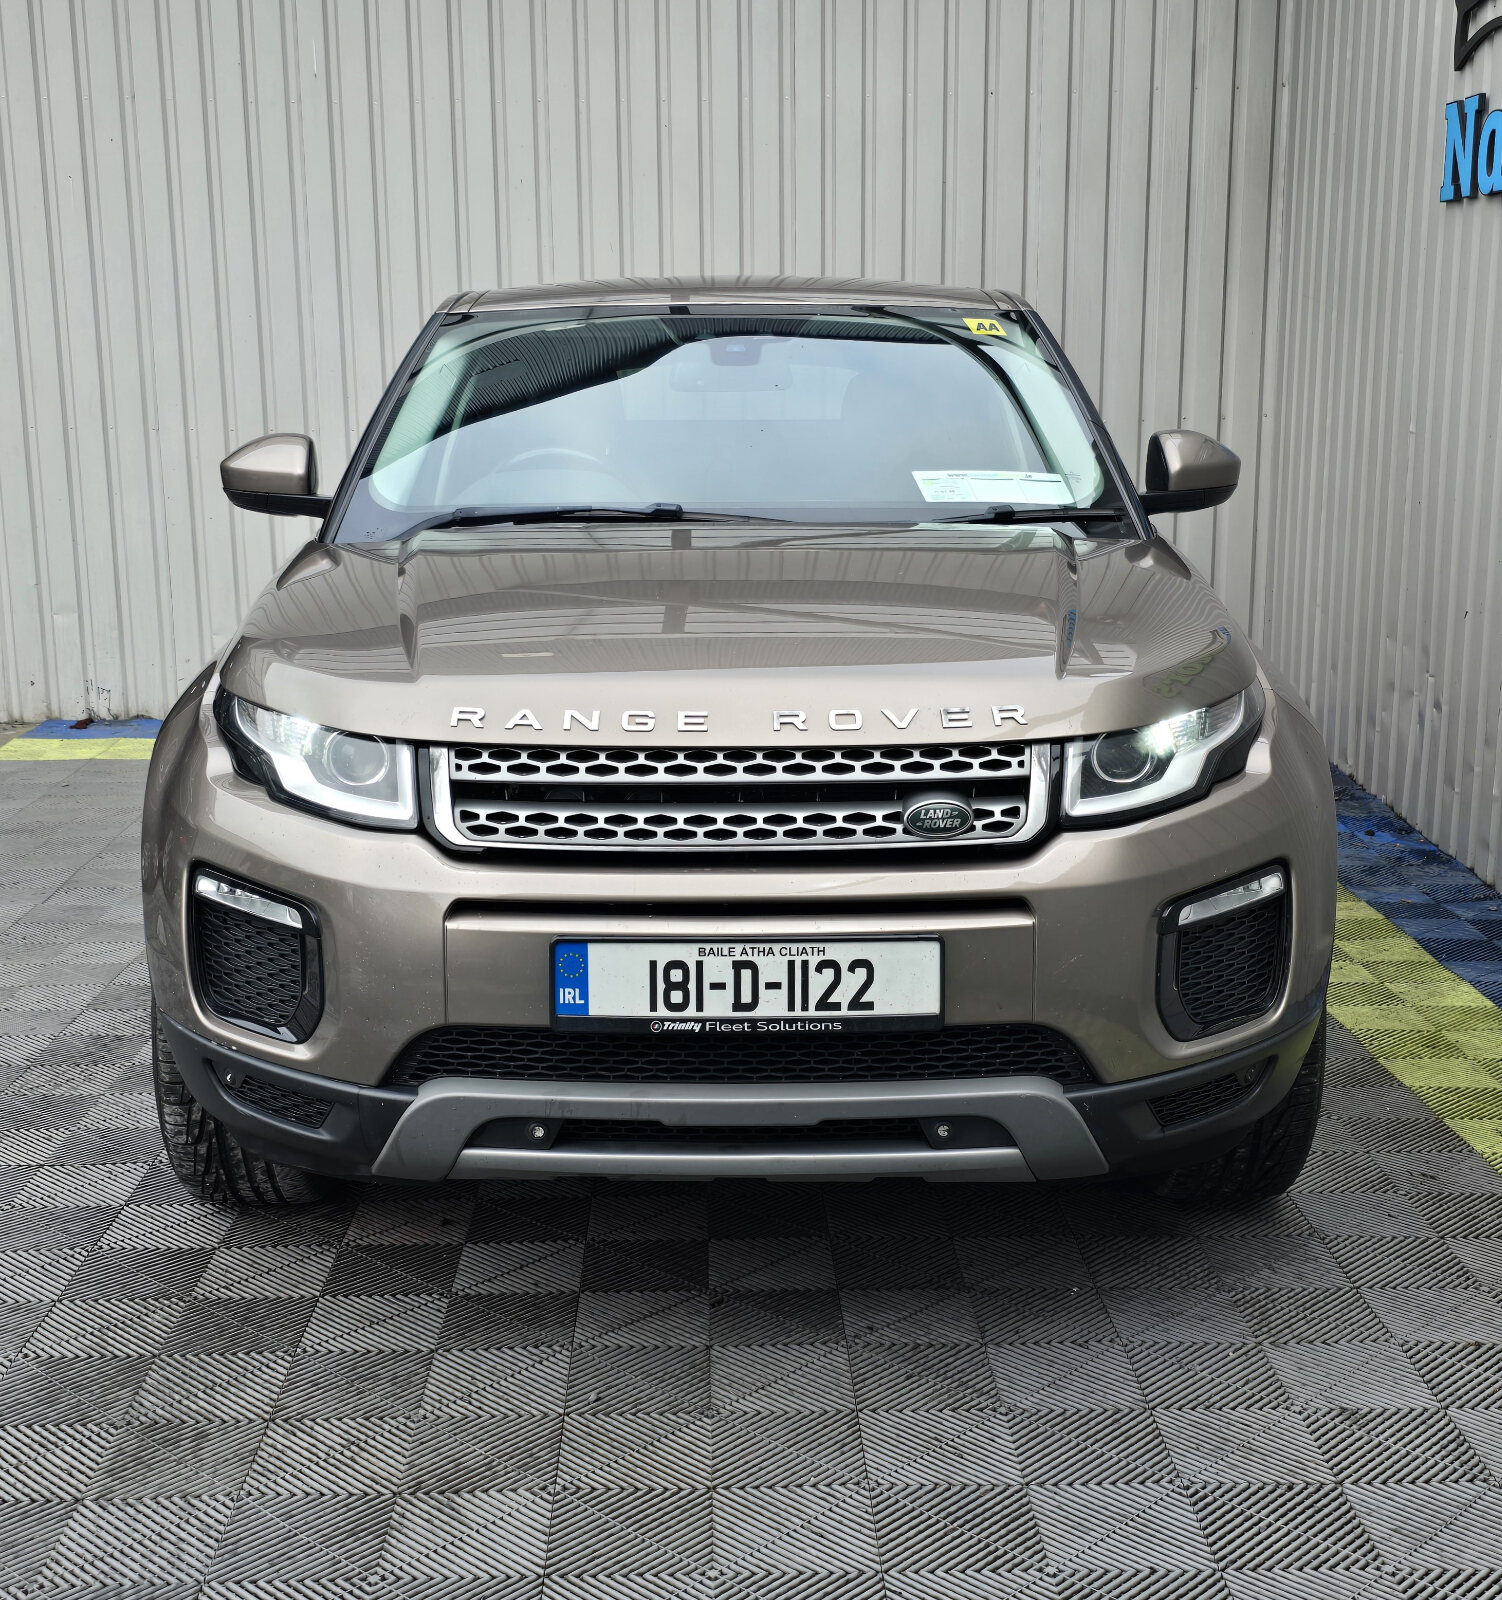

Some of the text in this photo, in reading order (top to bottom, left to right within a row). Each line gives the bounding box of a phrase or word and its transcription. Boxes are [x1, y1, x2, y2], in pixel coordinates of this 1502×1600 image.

[976, 322, 1000, 332] AA
[450, 704, 1029, 732] RANGE ROVER
[919, 808, 952, 819] LAND
[922, 818, 961, 829] ROVER
[698, 944, 826, 957] BAILE ÁTHA CLIATH
[649, 958, 875, 1013] 181-D-1122
[559, 987, 585, 1004] IRL
[663, 1020, 842, 1033] Trinity Fleet Solutions
